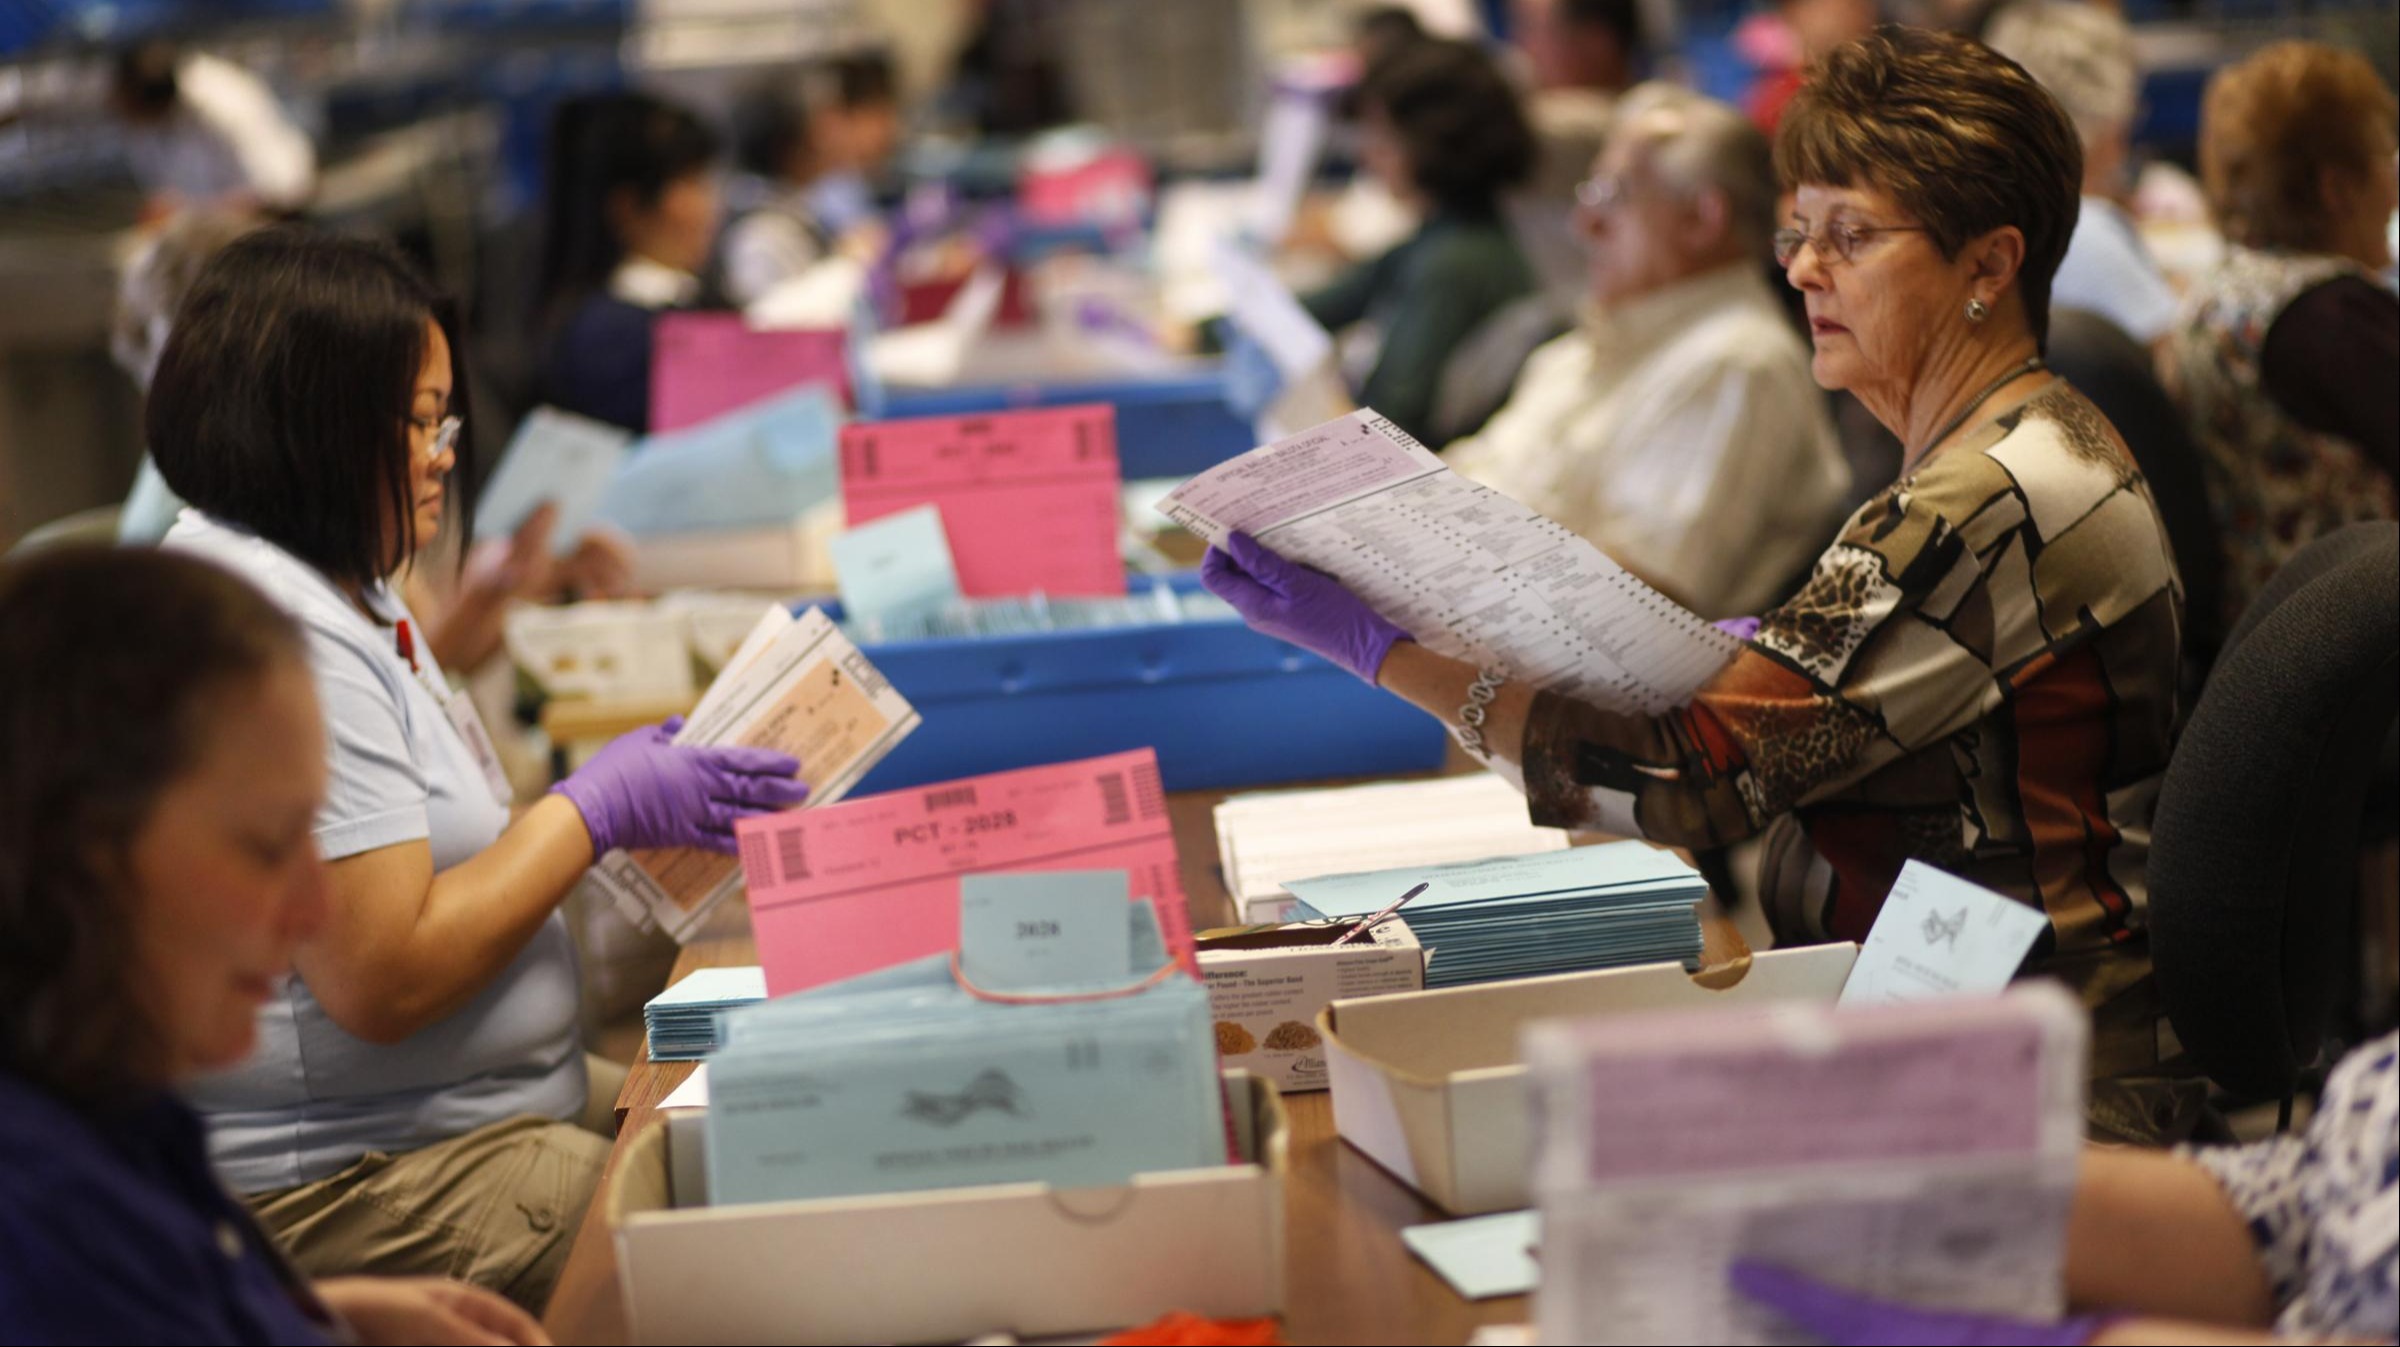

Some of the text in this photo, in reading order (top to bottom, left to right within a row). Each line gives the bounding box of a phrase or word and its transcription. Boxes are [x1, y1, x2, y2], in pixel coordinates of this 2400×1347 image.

[894, 821, 941, 846] PCT
[964, 809, 1018, 834] 2028
[1202, 970, 1248, 980] ifference:
